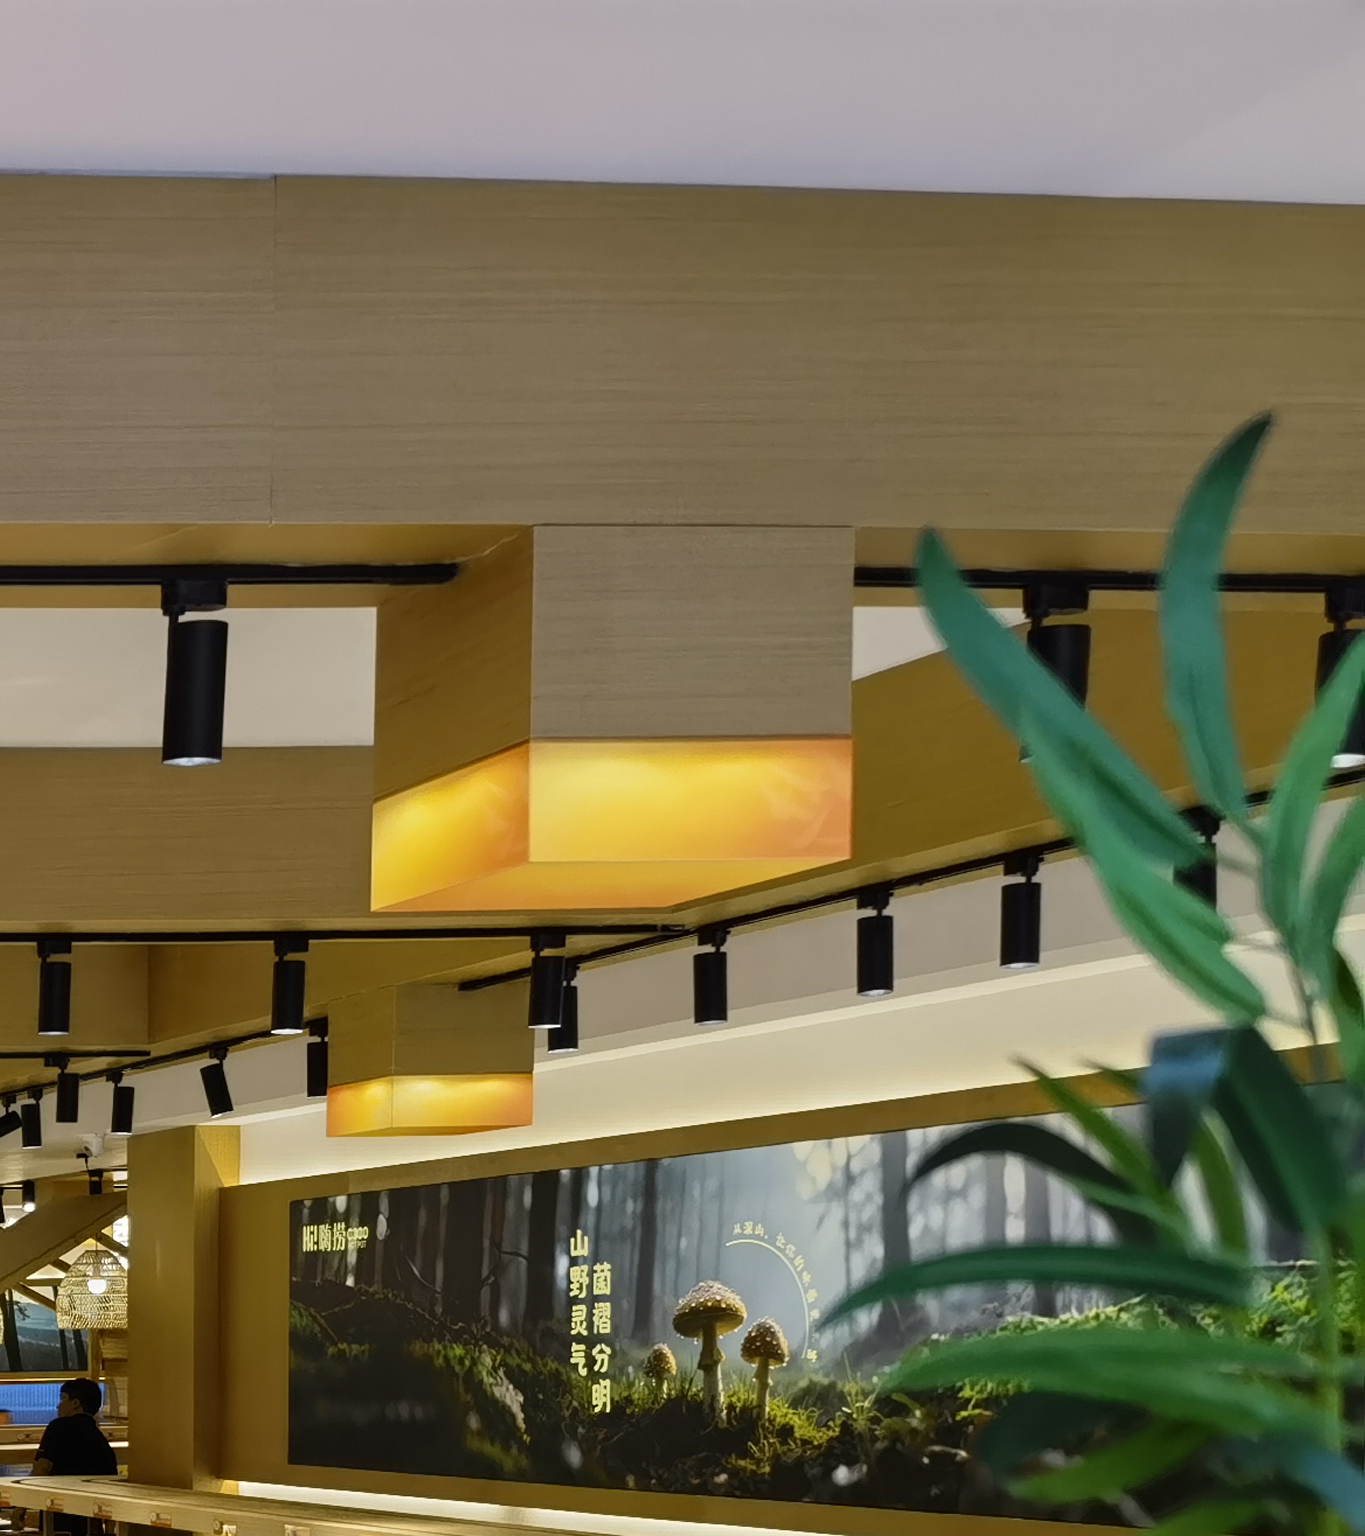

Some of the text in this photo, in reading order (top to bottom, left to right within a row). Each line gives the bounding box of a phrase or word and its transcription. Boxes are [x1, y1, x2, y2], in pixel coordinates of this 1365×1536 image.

[569, 1229, 589, 1377] 山野灵气
[592, 1262, 612, 1413] 菌褶分明
